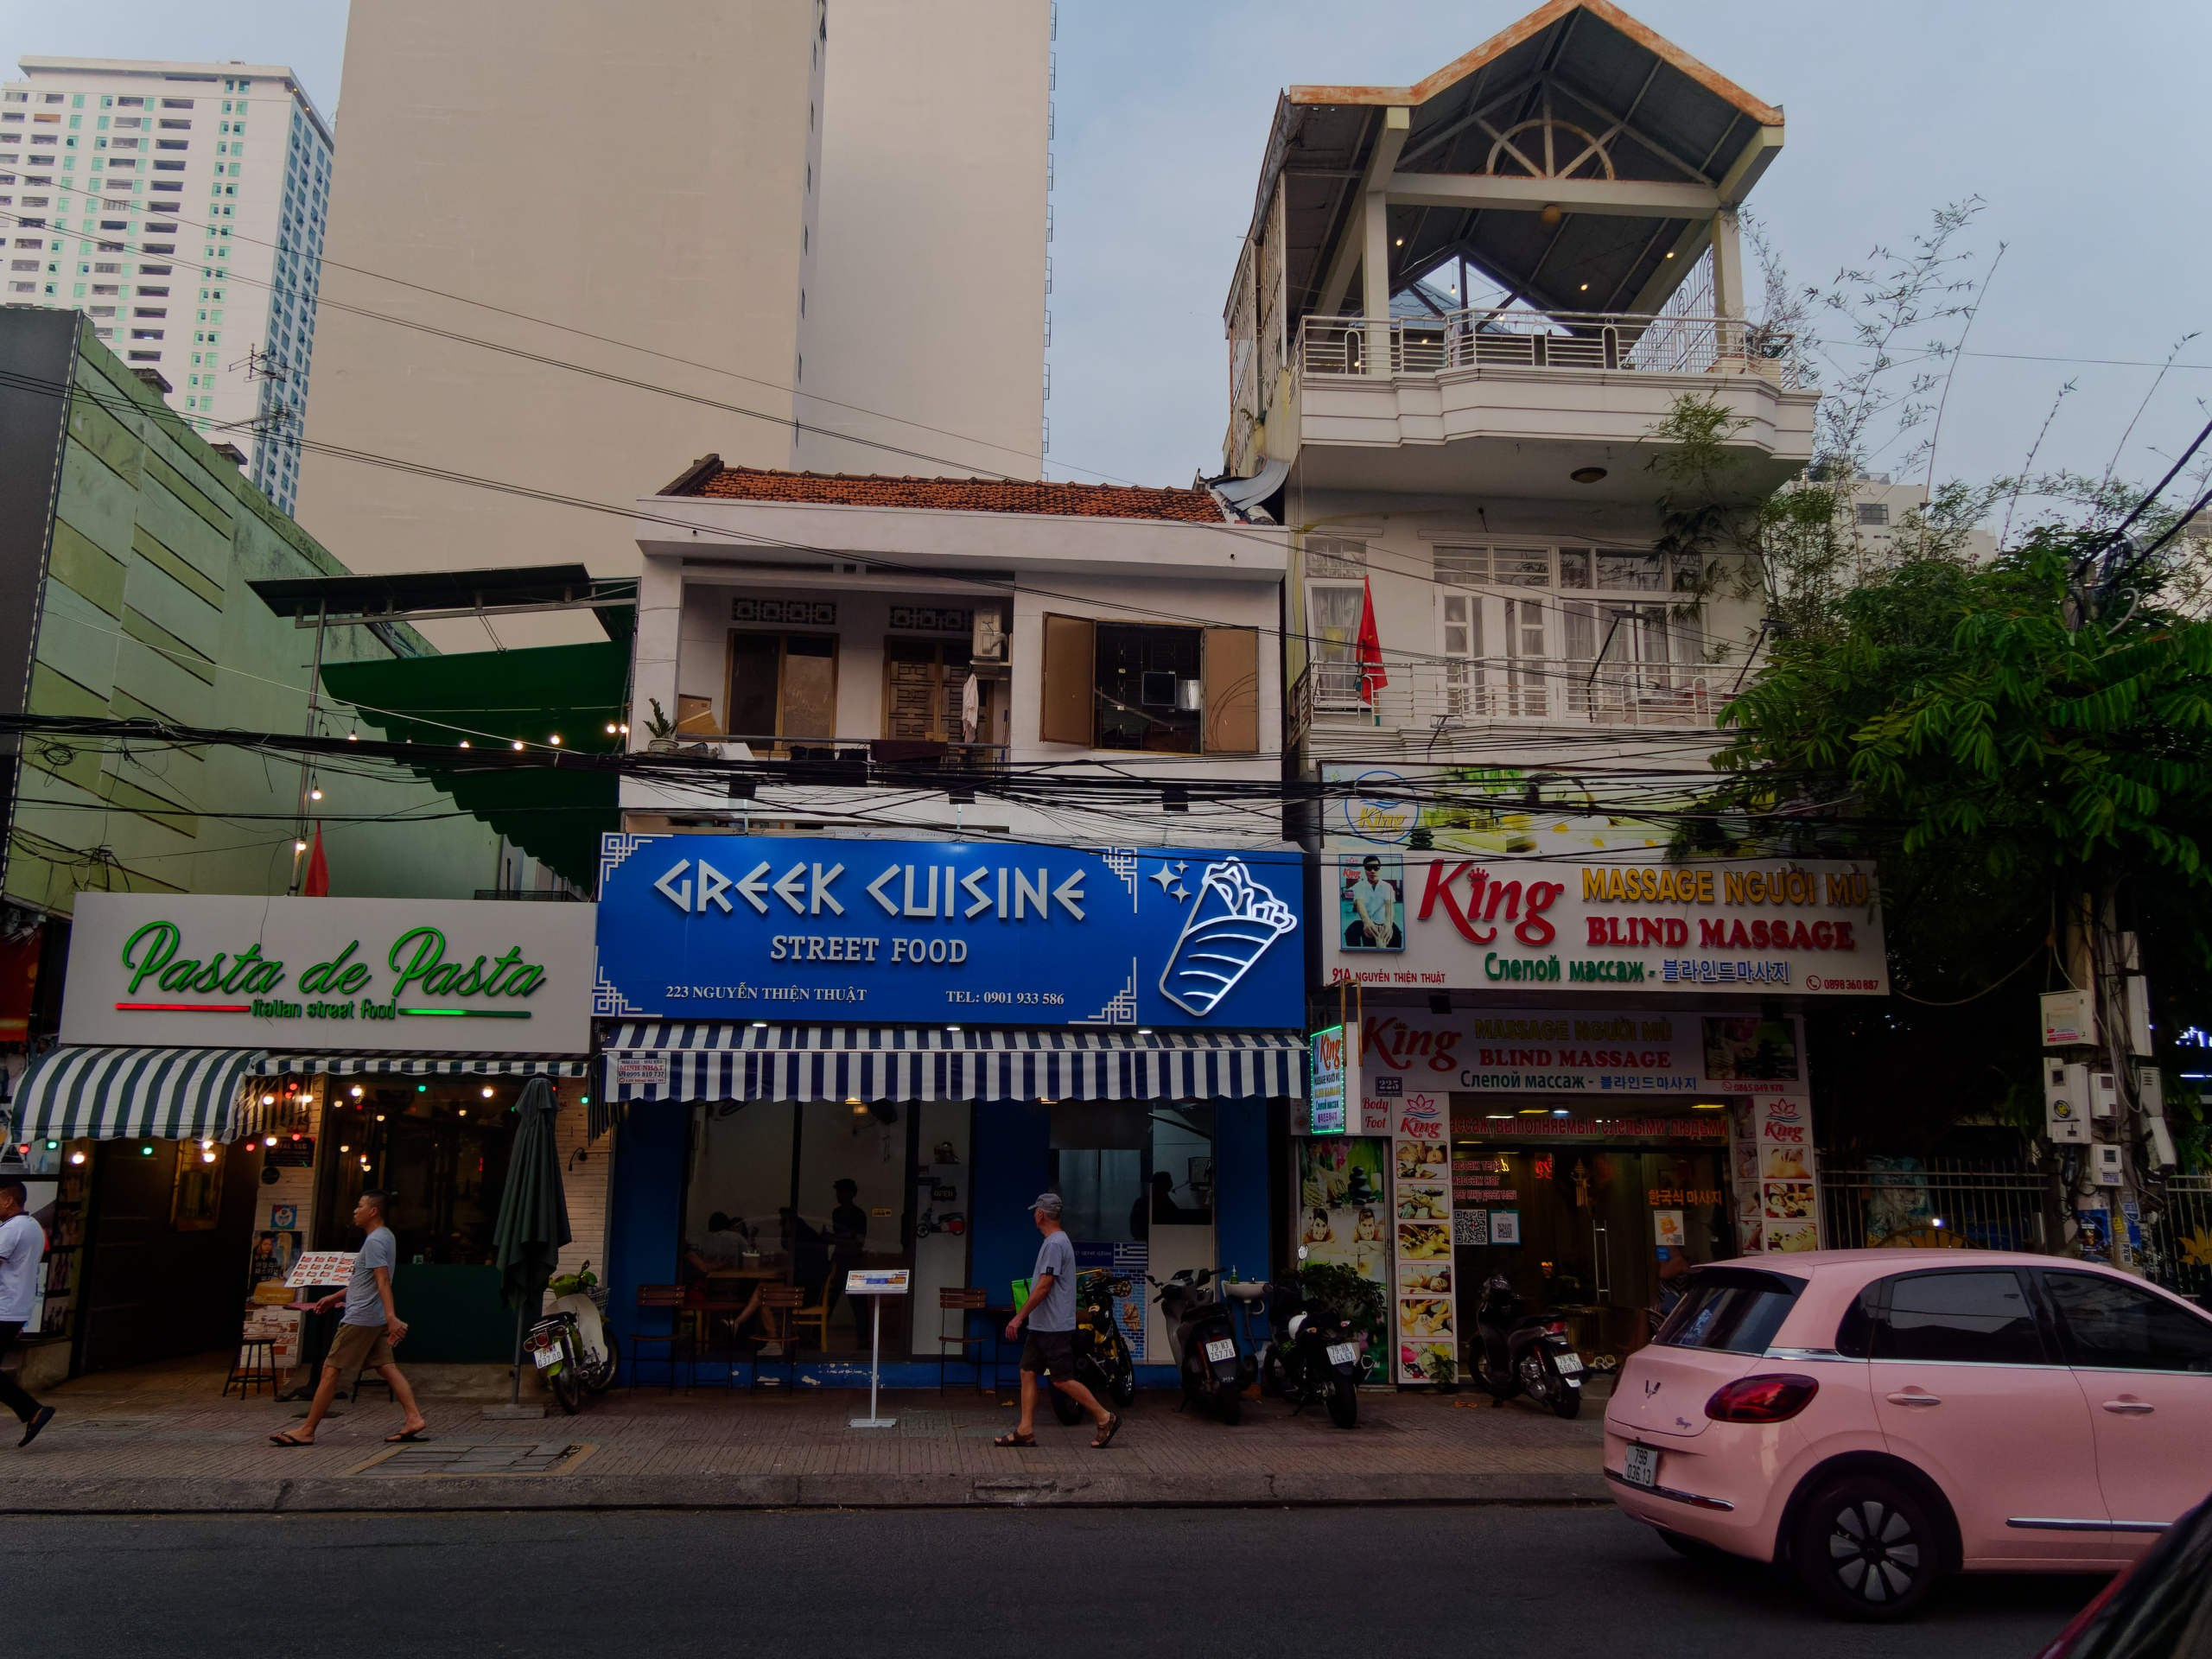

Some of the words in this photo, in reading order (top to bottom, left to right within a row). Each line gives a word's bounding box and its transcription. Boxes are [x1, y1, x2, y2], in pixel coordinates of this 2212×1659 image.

[1358, 807, 1407, 835] King
[1343, 868, 1362, 880] King
[1582, 868, 1715, 903] MASSAGE
[1723, 862, 1816, 905] NGƯỜI
[1825, 865, 1870, 906] MÙ
[653, 858, 849, 917] GREEK
[865, 862, 1085, 921] CUISINE
[1418, 858, 1565, 947] King
[1586, 917, 1689, 946] BLIND
[1698, 918, 1855, 950] MASSAGE
[123, 920, 284, 994] Pasta
[298, 939, 372, 995] de
[388, 927, 547, 997] Pasta
[770, 935, 878, 963] STREET
[891, 938, 969, 963] FOOD
[1484, 952, 1560, 982] Слепой
[1569, 960, 1644, 982] массаж
[1662, 959, 1790, 984] 블라인드마사지
[665, 984, 690, 1000] 223
[692, 982, 759, 1001] NGUYỄN
[763, 985, 810, 1002] THIỆN
[813, 988, 867, 1003] THUẬT
[945, 989, 980, 1003] TEL:
[983, 991, 1012, 1004] 0901
[1016, 992, 1038, 1005] 933
[1042, 992, 1065, 1006] 586
[307, 1001, 355, 1020] street
[360, 1000, 396, 1020] food
[1475, 1019, 1570, 1042] MASSAGE
[1320, 1034, 1342, 1071] King
[1363, 1016, 1462, 1072] King
[1479, 1049, 1551, 1066] BLIND
[1558, 1051, 1672, 1069] MASSAGE
[1460, 1069, 1521, 1090] Слепой
[1524, 1075, 1586, 1090] массаж
[1600, 1075, 1697, 1091] 블라인드마사지
[1363, 1096, 1389, 1114] Body
[1400, 1116, 1443, 1139] King
[1764, 1121, 1806, 1142] King
